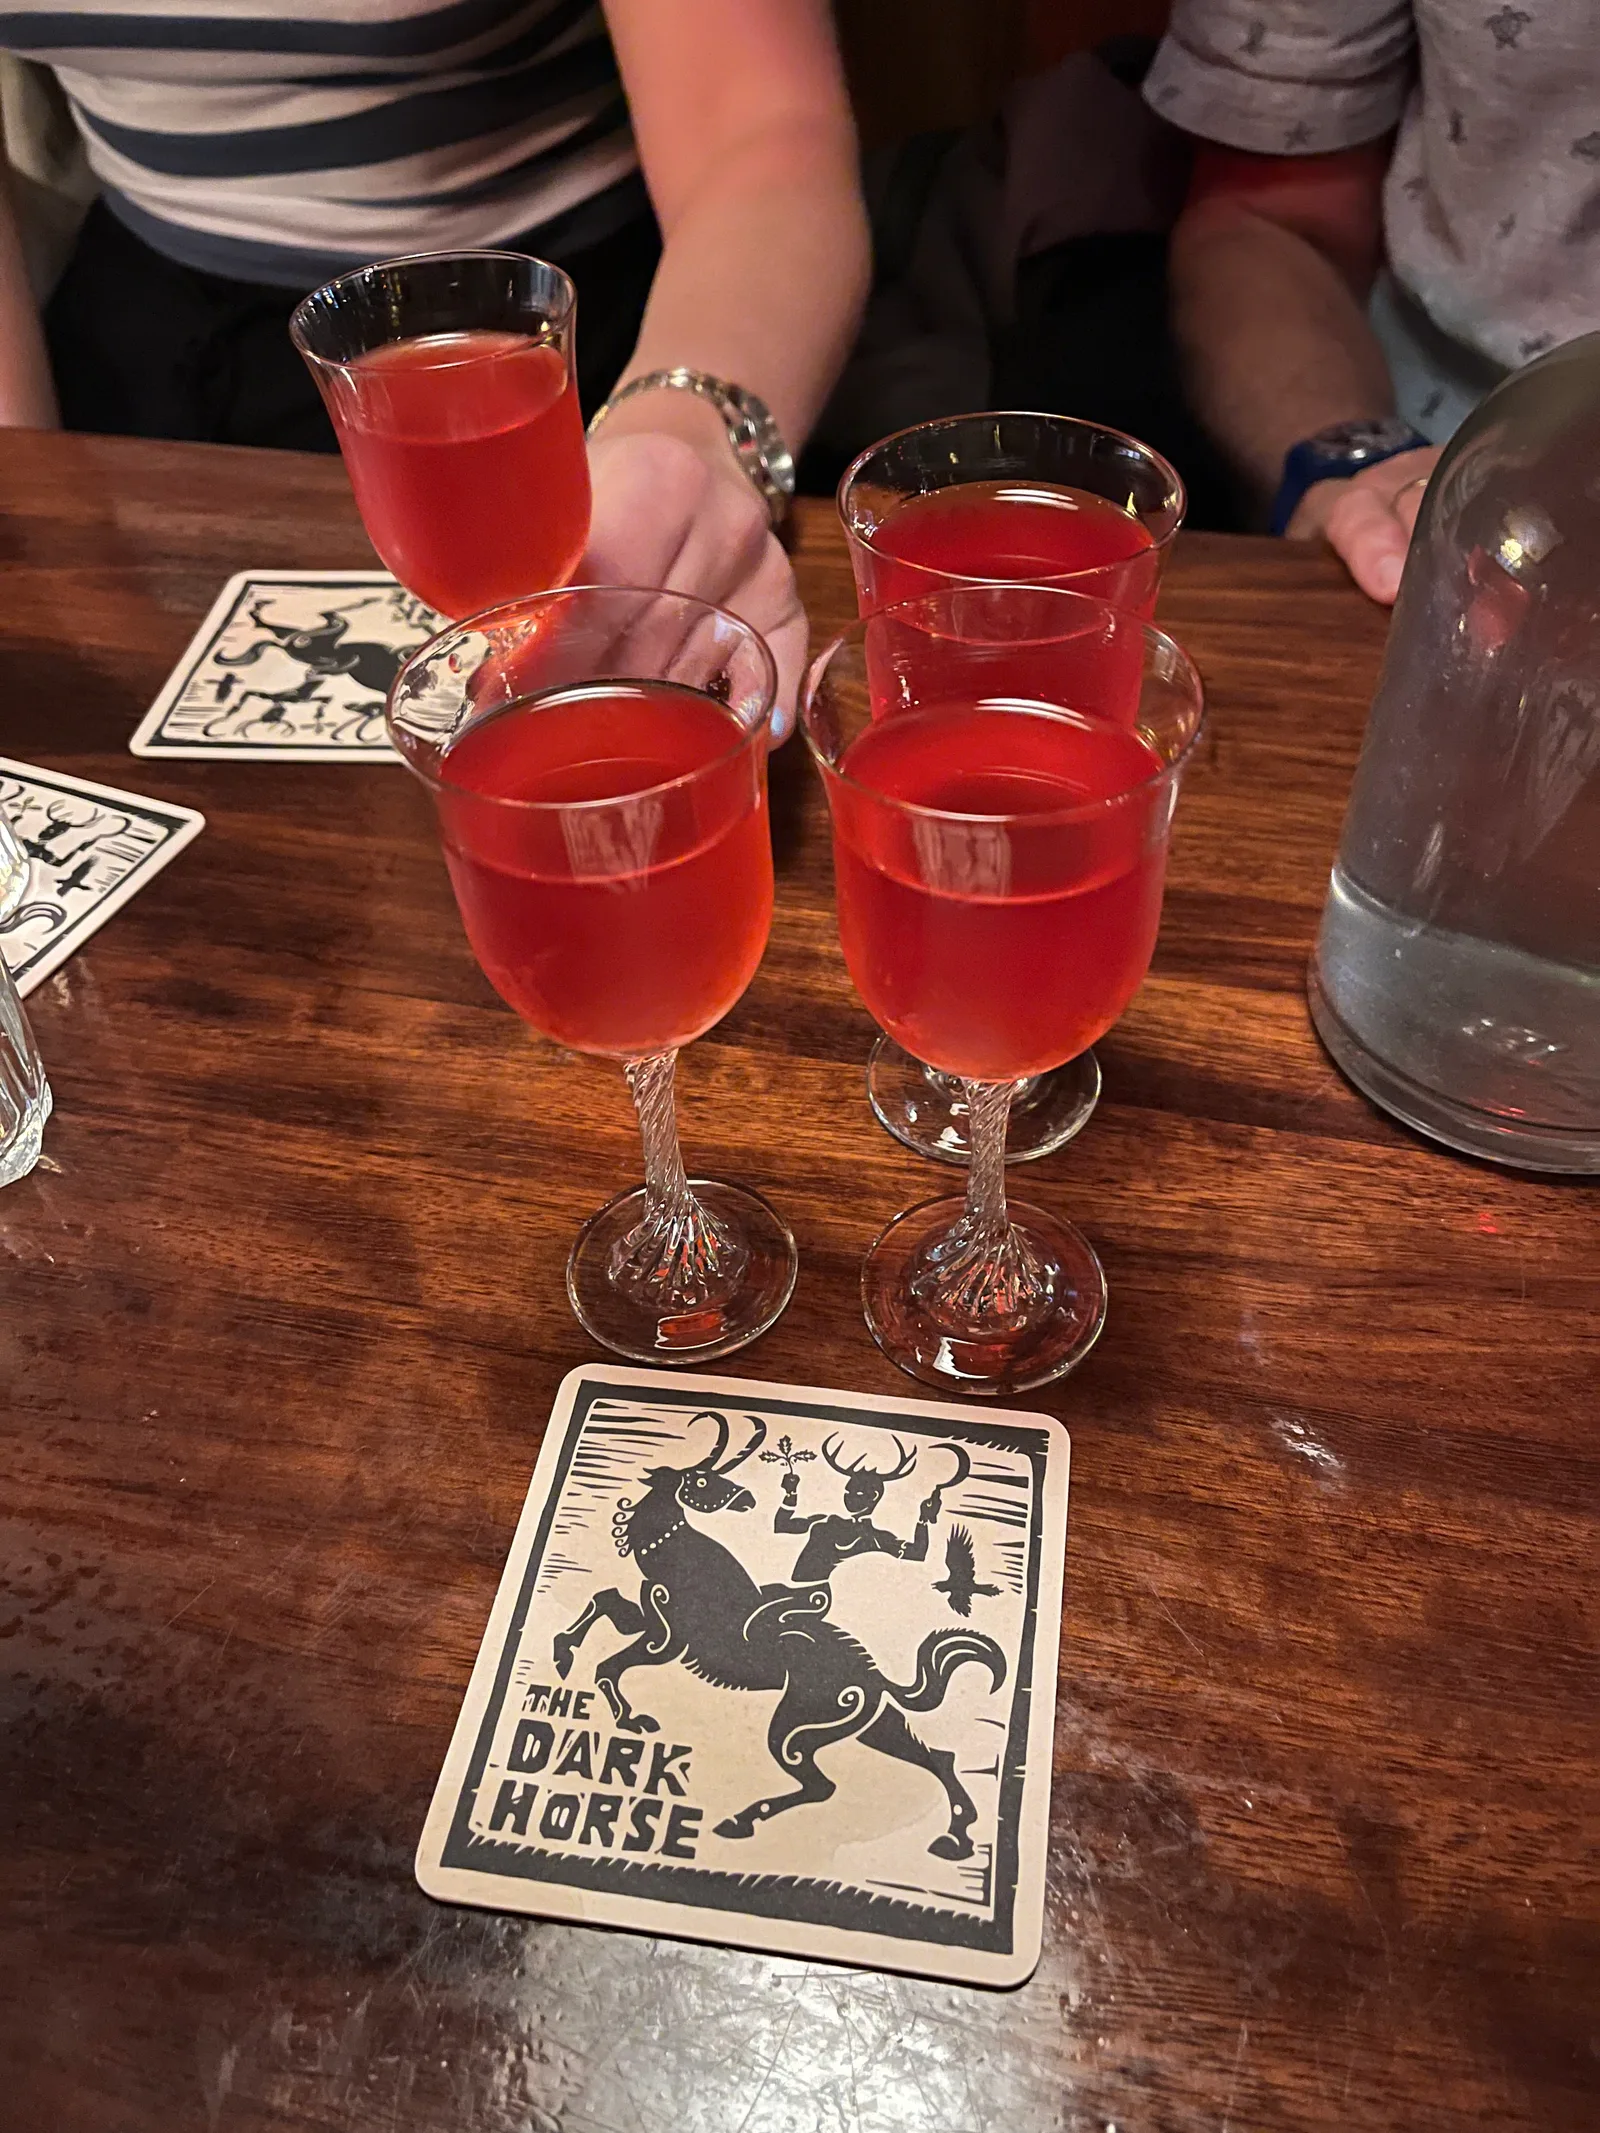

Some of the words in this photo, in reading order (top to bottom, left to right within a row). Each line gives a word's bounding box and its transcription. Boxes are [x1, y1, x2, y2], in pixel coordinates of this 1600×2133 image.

[522, 1684, 595, 1720] THE
[507, 1719, 693, 1796] DARK
[489, 1779, 704, 1859] HORSE
